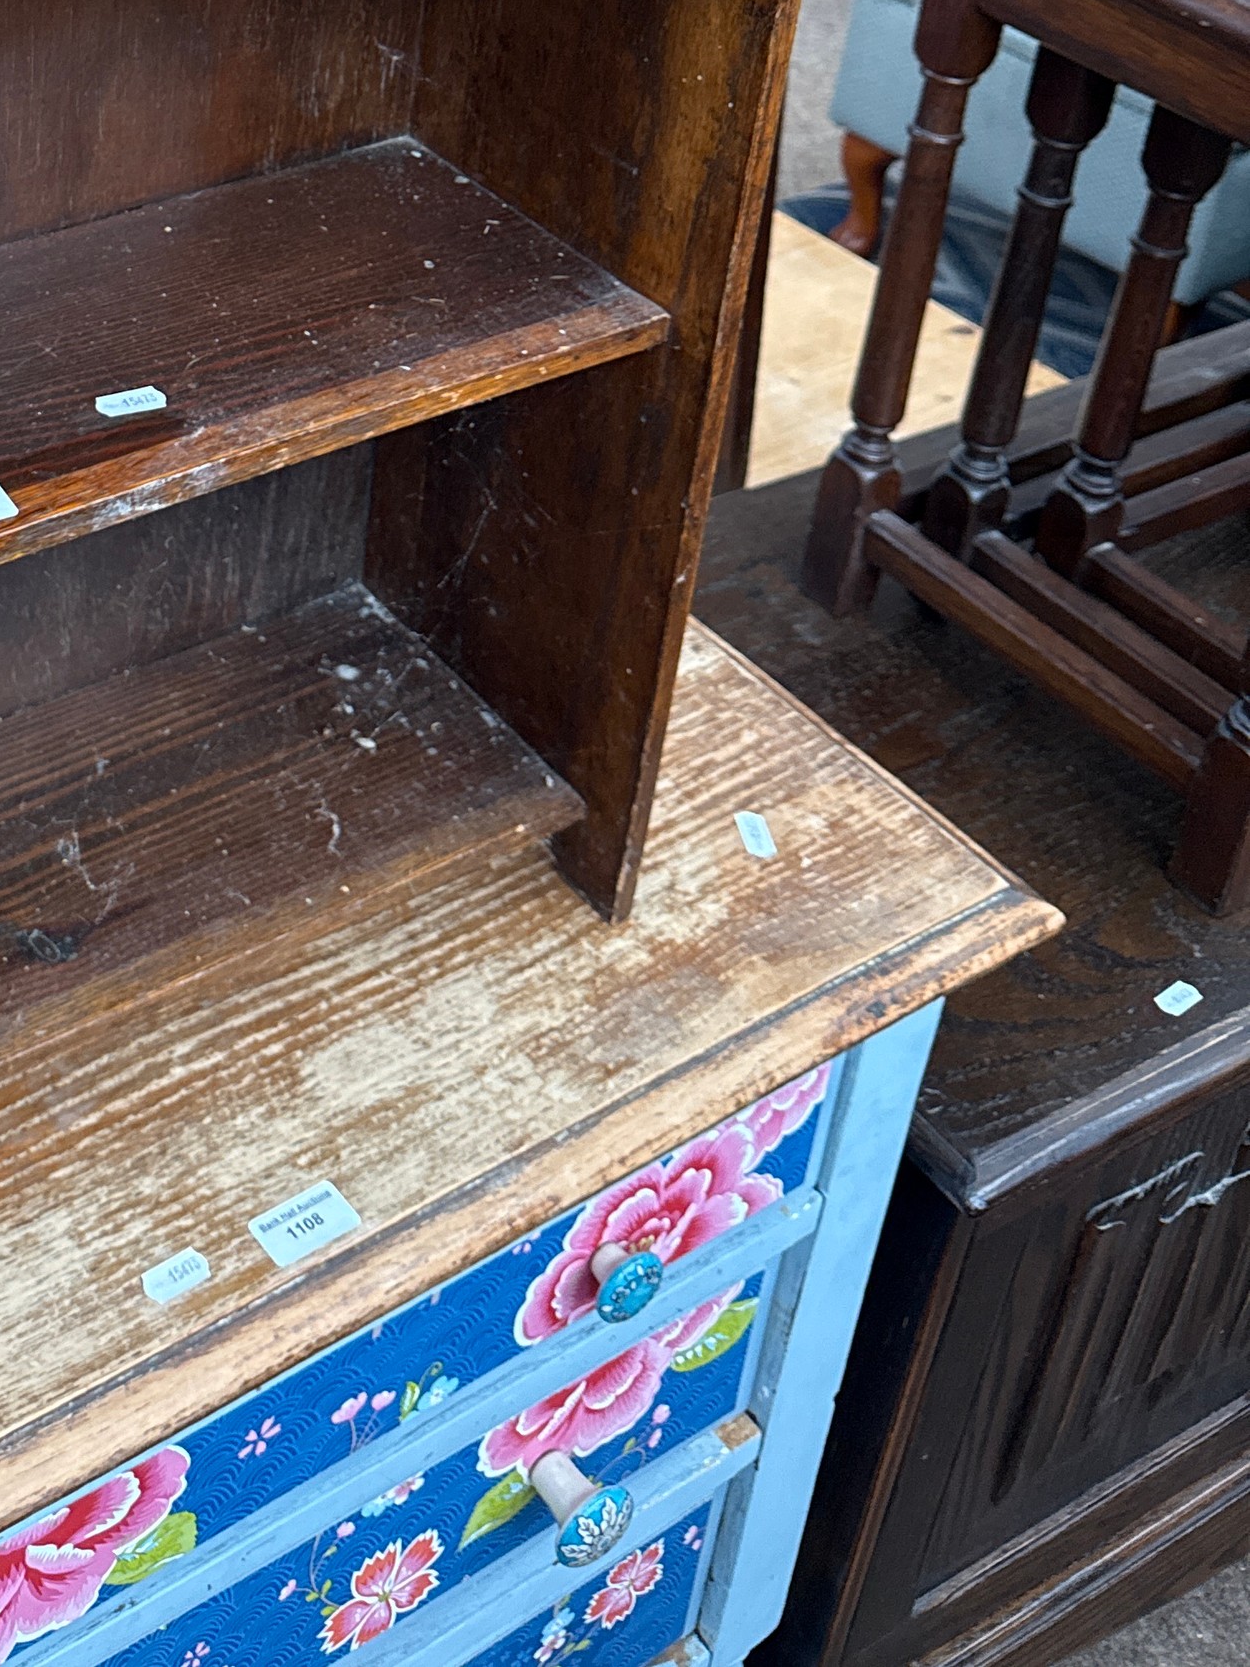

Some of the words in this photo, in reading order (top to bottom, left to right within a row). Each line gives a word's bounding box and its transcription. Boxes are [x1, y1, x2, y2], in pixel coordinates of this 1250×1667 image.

[258, 1216, 281, 1233] Bank
[280, 1207, 297, 1222] Hall
[296, 1189, 332, 1213] Auctions
[286, 1212, 325, 1239] 1108
